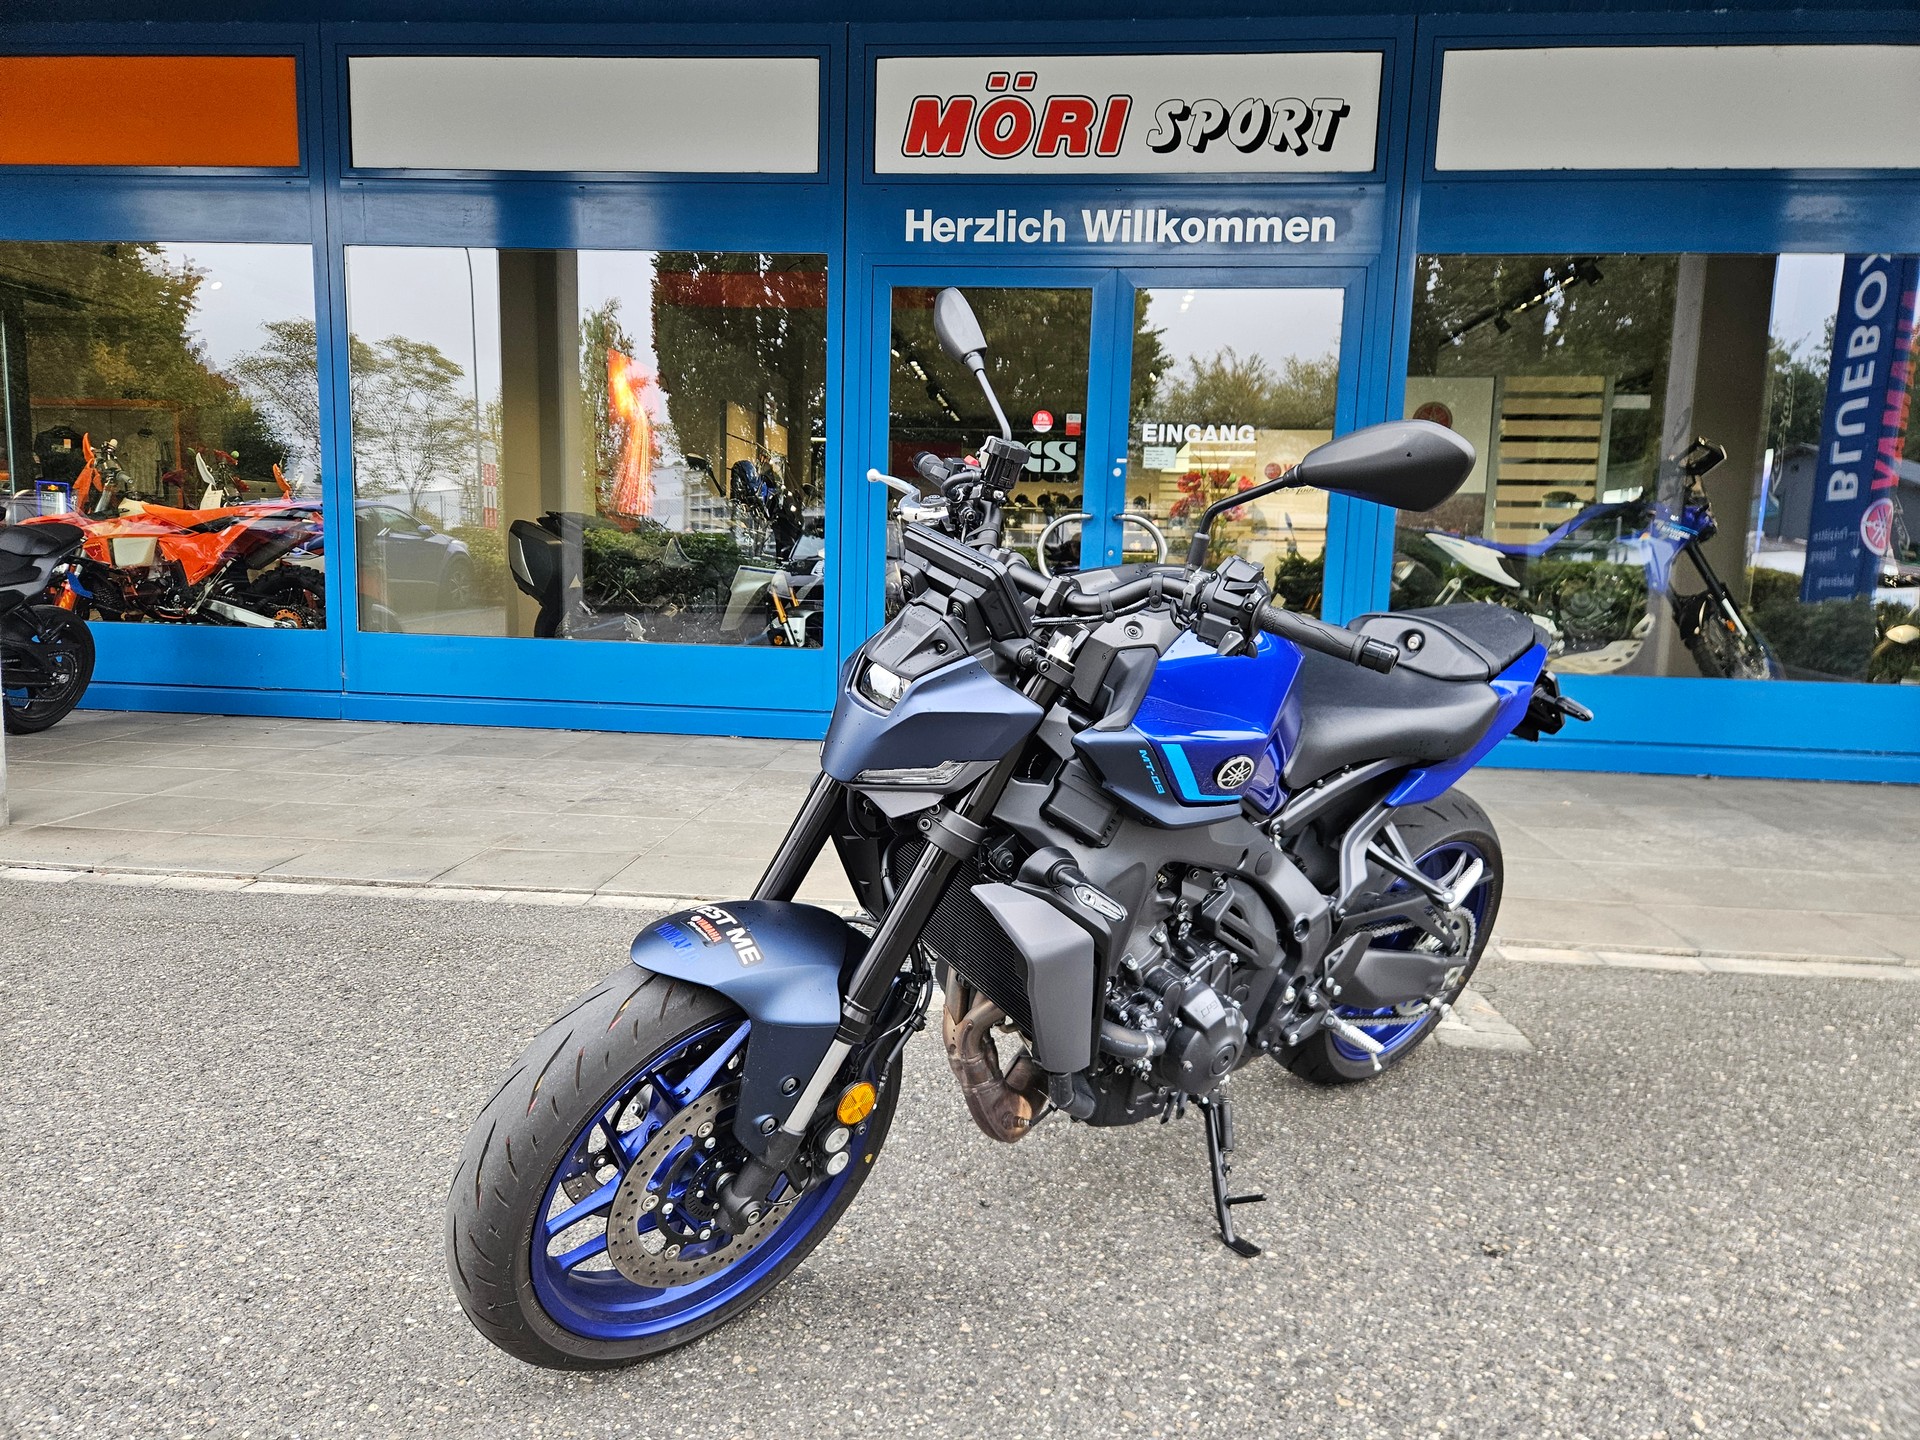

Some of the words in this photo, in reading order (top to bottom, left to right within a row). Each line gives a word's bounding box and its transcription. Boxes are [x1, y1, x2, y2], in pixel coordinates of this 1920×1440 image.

[902, 71, 1133, 159] MÖRI
[1145, 97, 1351, 156] SPORT
[905, 209, 1066, 243] Herzlich
[1081, 209, 1336, 243] Willkommen
[1871, 290, 1919, 490] YAMAHA
[1142, 423, 1256, 443] EINGANG
[1138, 749, 1166, 794] MT-09
[696, 917, 722, 943] YAMAHA
[726, 927, 762, 965] ME
